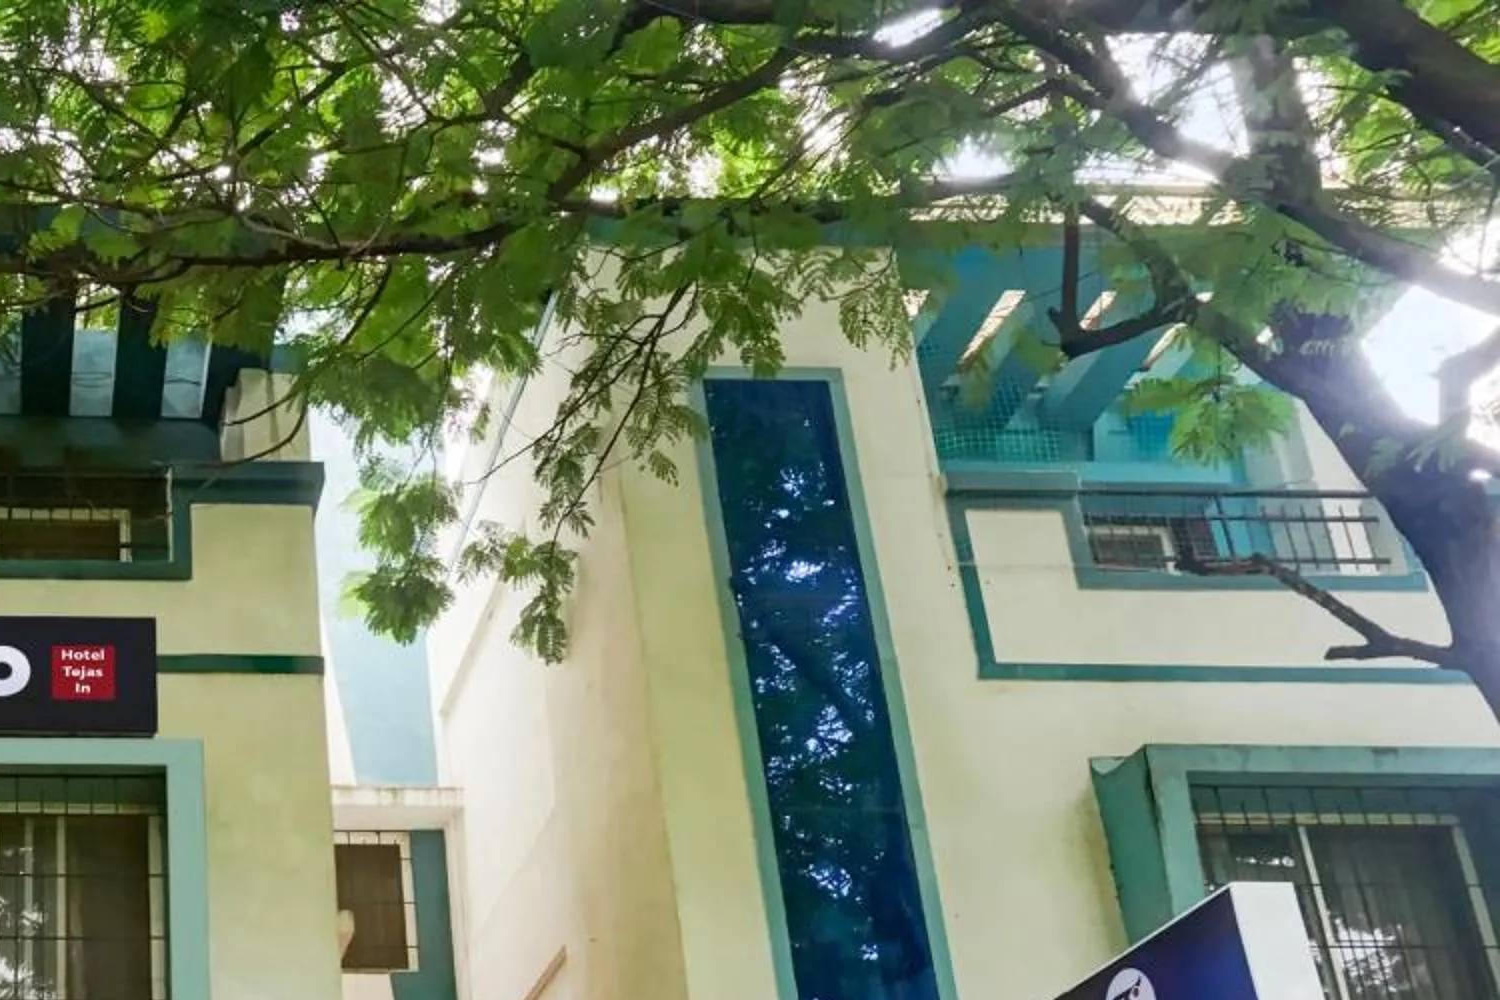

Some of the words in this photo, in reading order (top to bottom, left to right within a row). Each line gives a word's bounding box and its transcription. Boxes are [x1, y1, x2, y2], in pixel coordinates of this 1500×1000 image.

[61, 648, 105, 661] Hotel
[61, 665, 103, 680] Tejas
[75, 682, 91, 693] In
